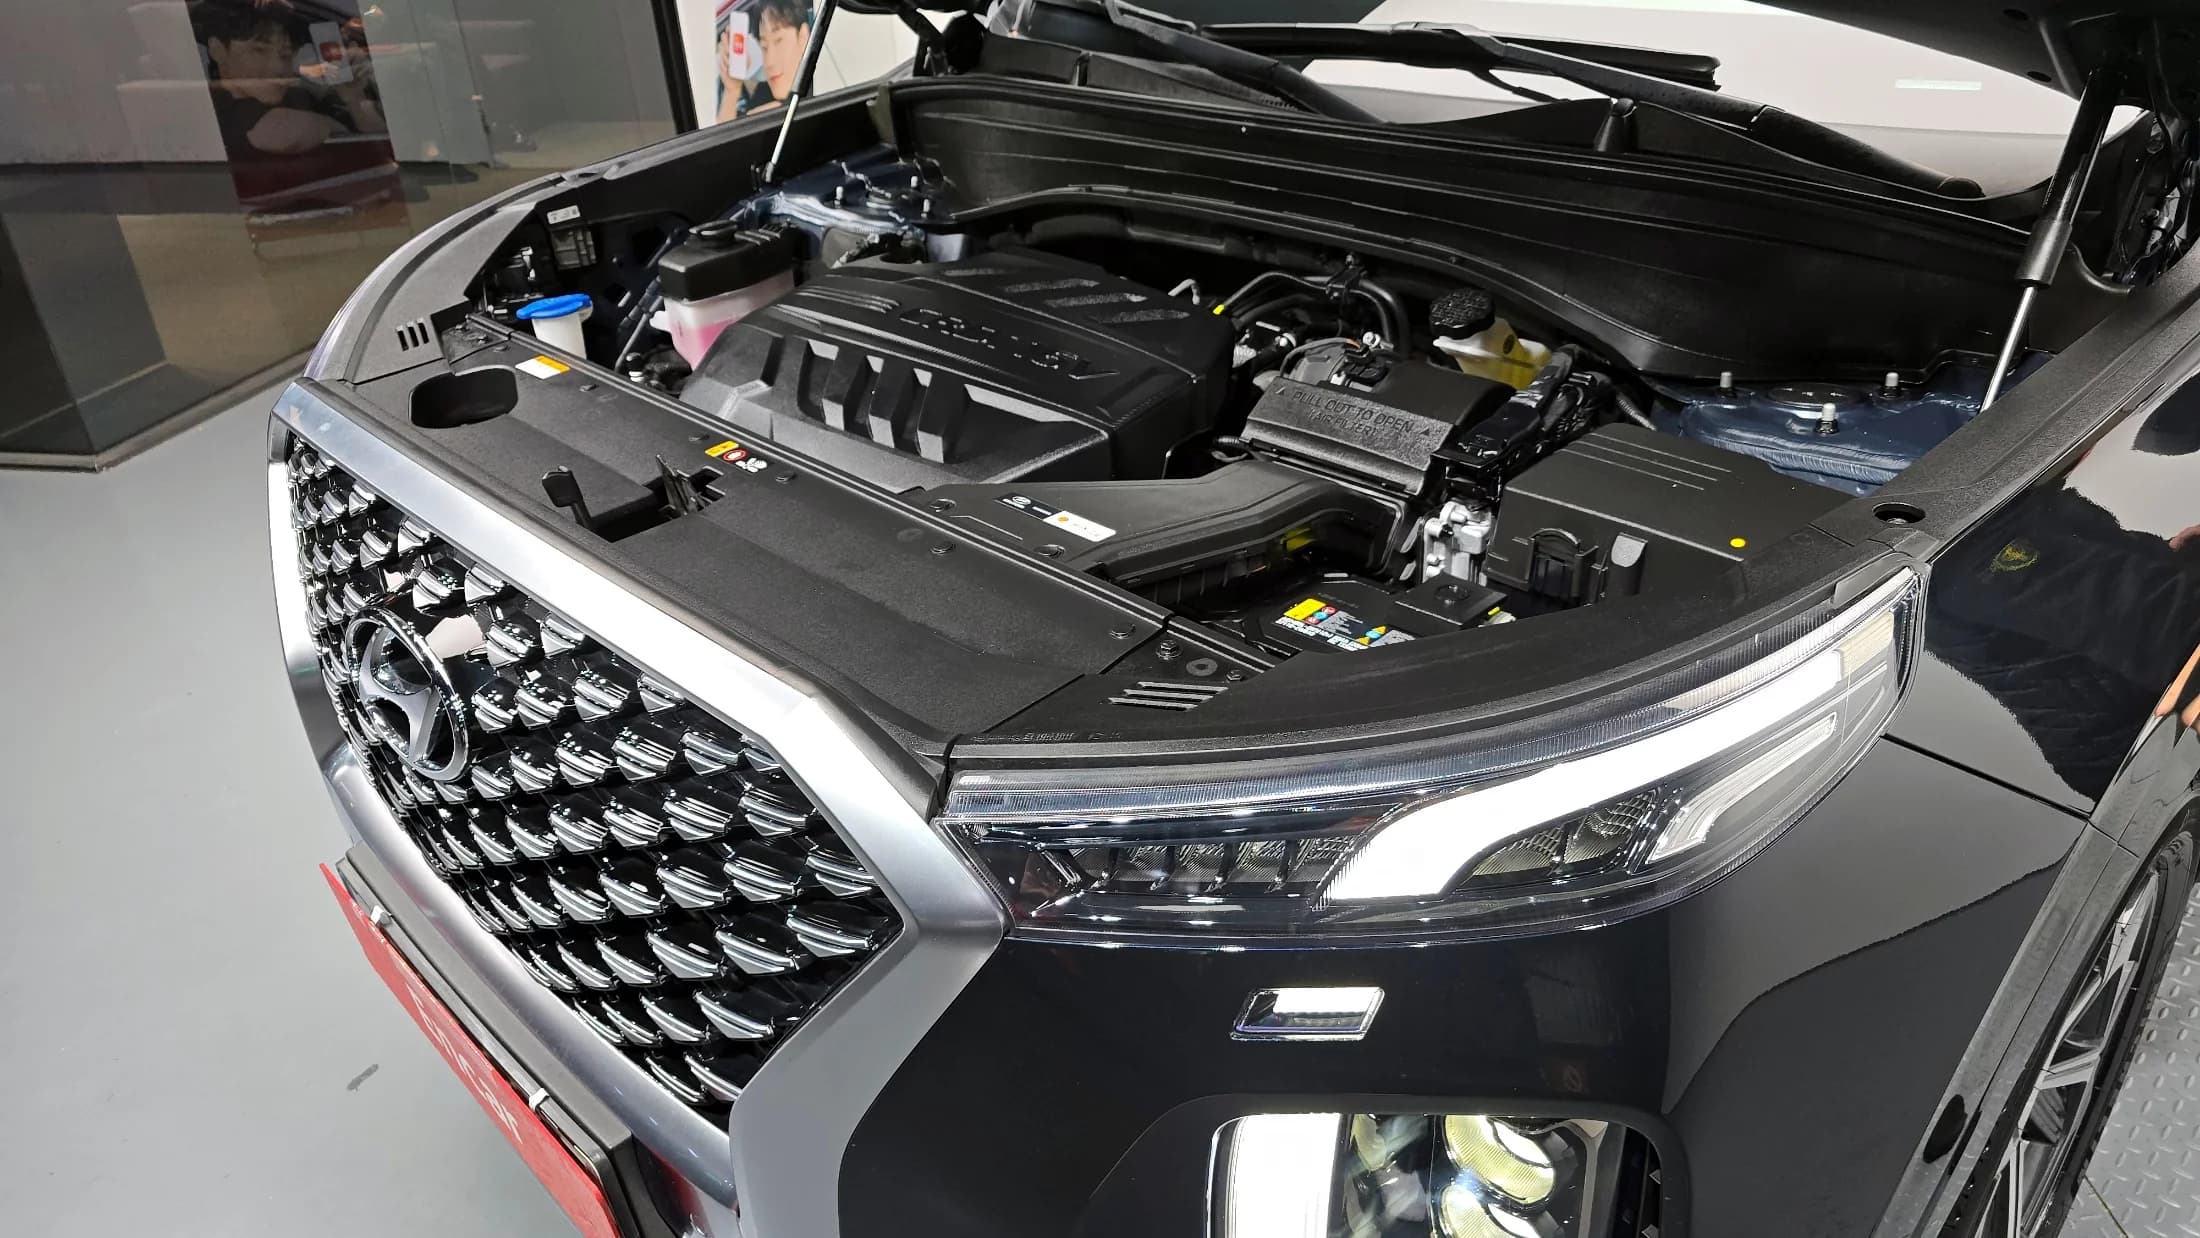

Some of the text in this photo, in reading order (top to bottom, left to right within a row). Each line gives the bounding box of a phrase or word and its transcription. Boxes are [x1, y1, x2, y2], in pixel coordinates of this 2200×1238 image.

[1293, 391, 1414, 433] PULL OUT TO OPEN
